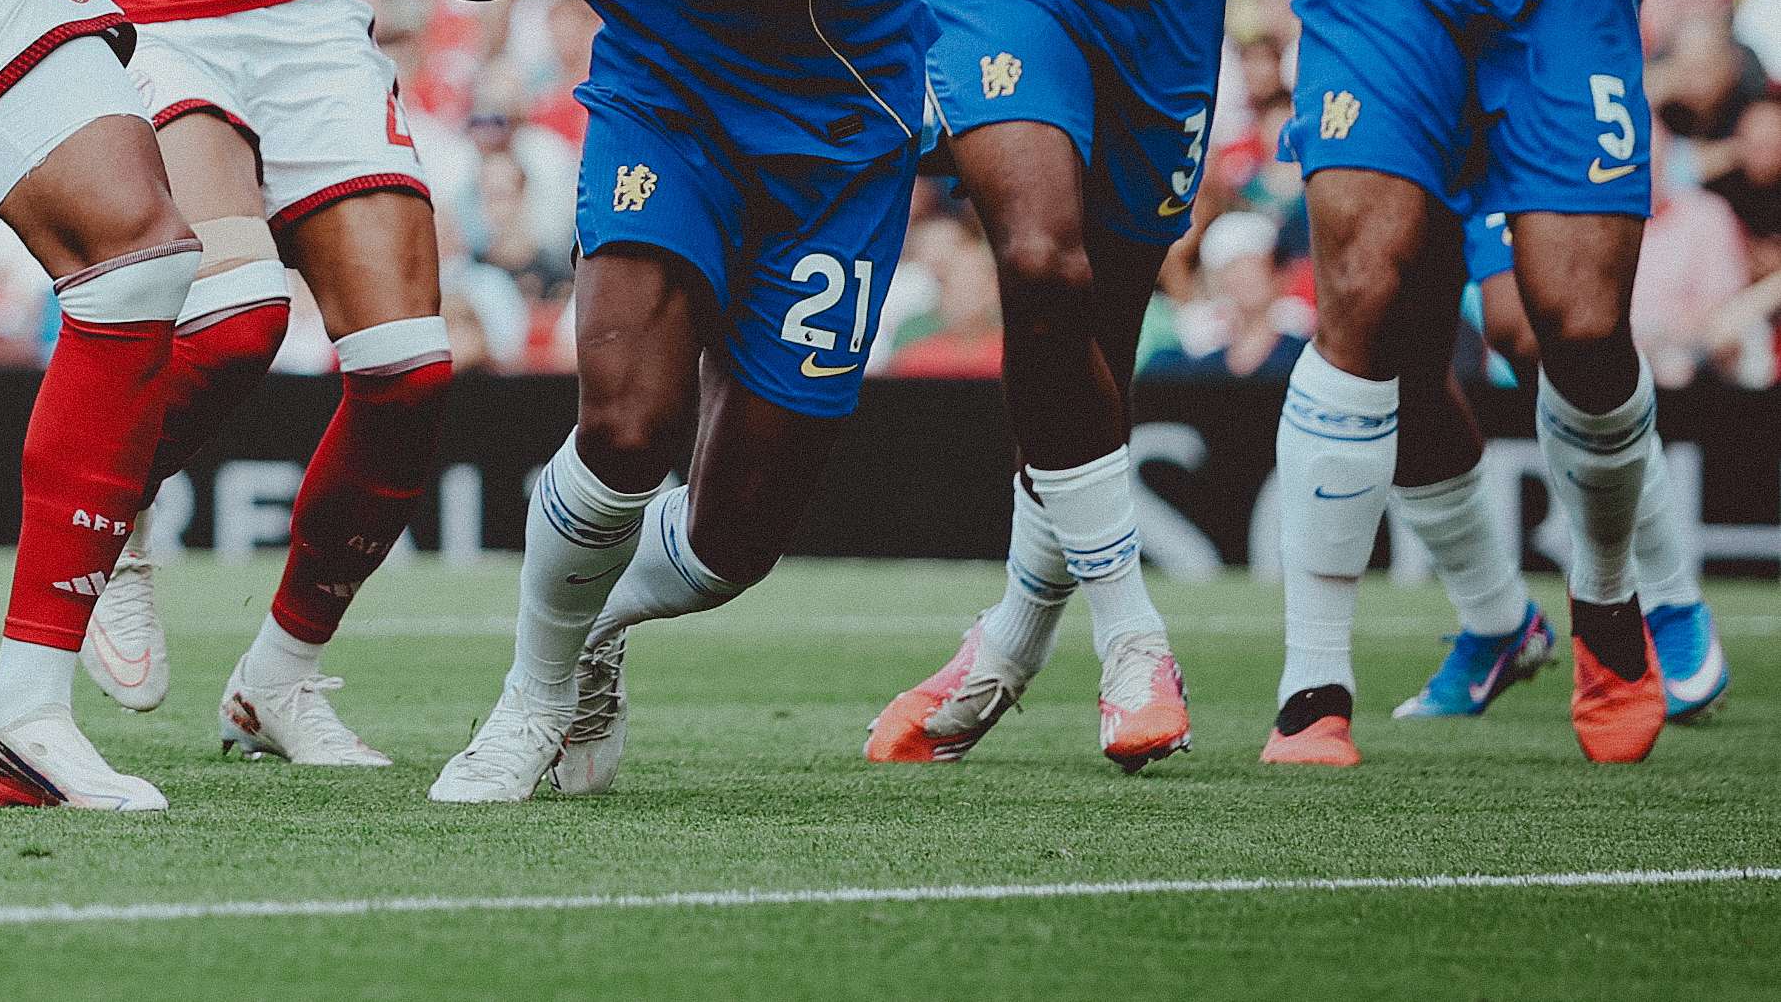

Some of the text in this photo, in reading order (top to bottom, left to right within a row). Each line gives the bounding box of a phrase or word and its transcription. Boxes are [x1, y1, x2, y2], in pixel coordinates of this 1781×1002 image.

[1171, 107, 1207, 197] 3
[1589, 74, 1636, 161] 5
[780, 252, 875, 353] 21
